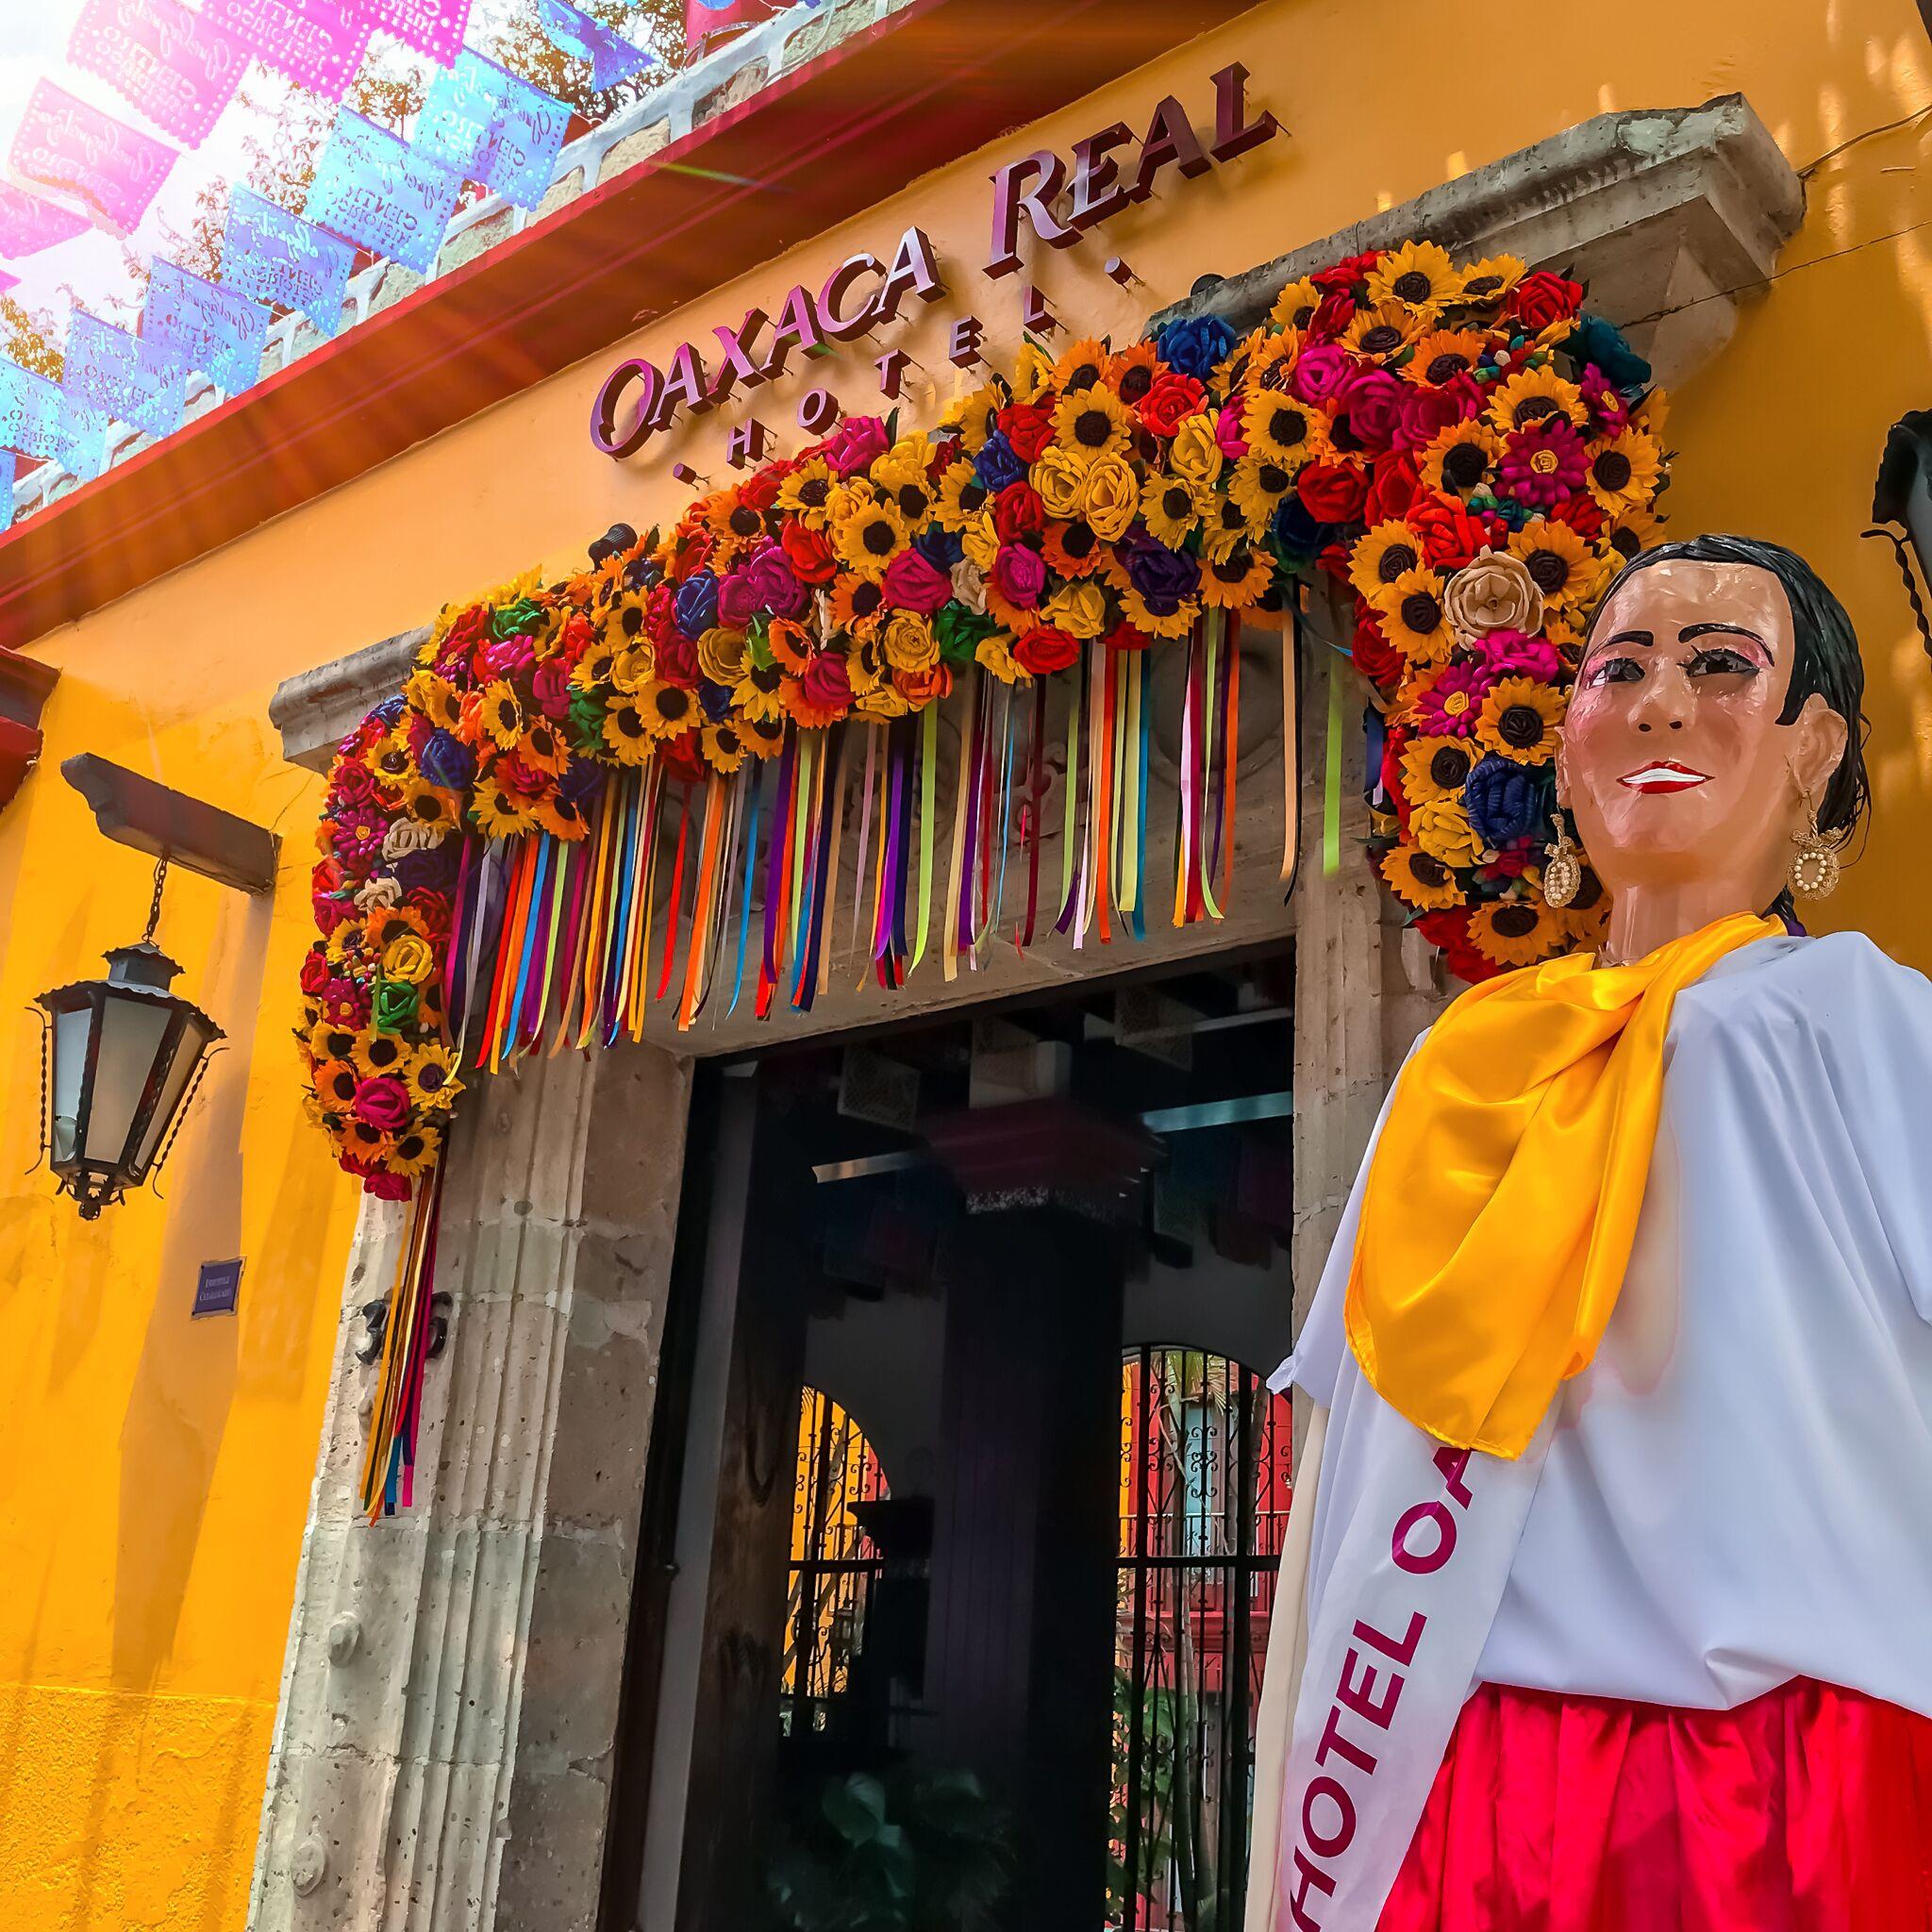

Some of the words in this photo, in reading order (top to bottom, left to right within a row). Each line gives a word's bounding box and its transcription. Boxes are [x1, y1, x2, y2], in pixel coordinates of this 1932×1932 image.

[591, 225, 946, 459] OAXACA
[982, 60, 1277, 280] REAL
[724, 284, 1056, 469] HOTEL
[1289, 1610, 1427, 1932] HOTEL
